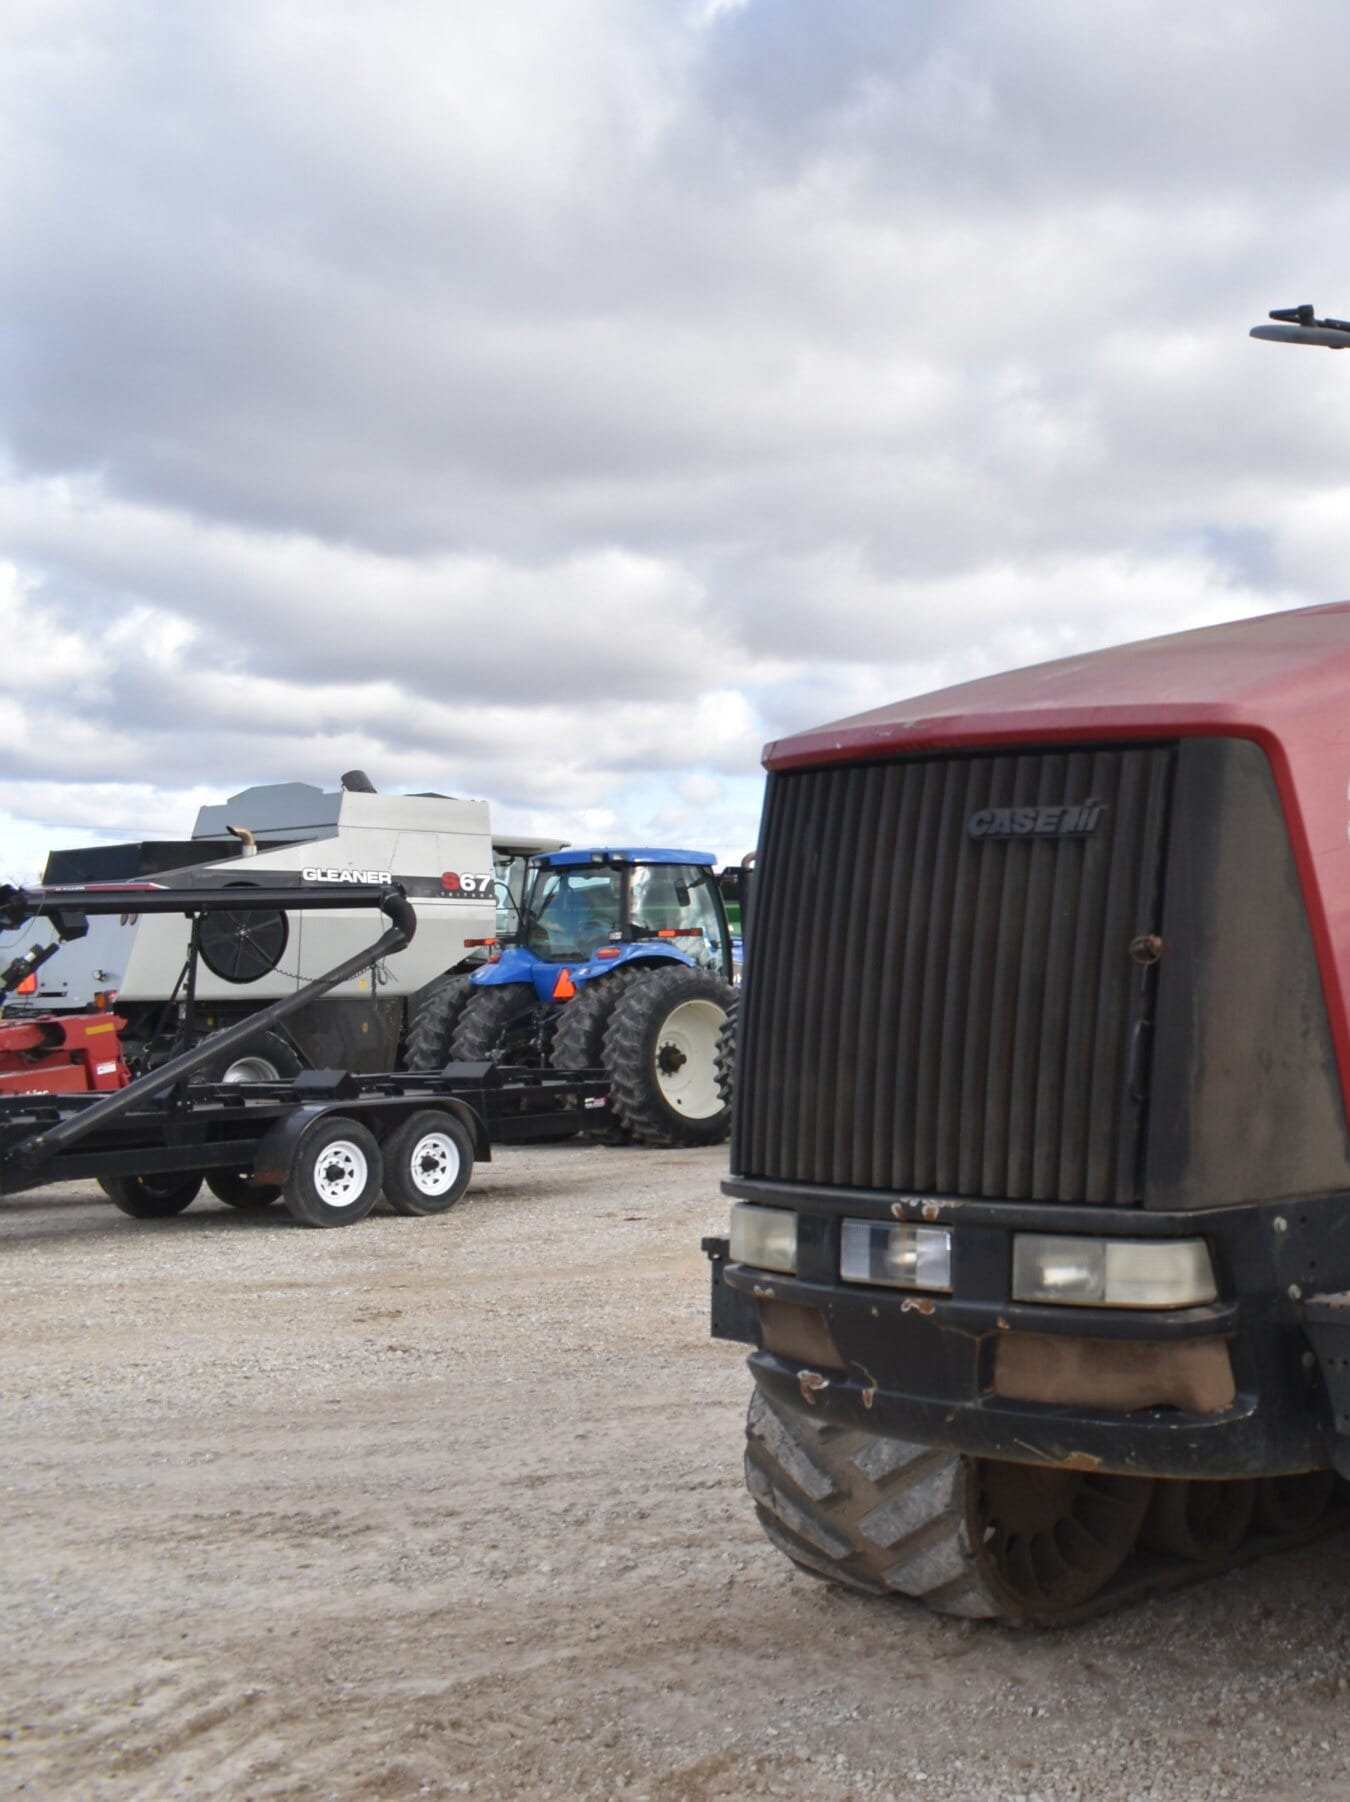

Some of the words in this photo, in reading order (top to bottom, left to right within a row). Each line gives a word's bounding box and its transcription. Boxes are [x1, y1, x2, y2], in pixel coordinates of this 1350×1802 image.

[968, 807, 1063, 837] CASE
[302, 867, 392, 885] GLEANER
[441, 871, 491, 892] S67
